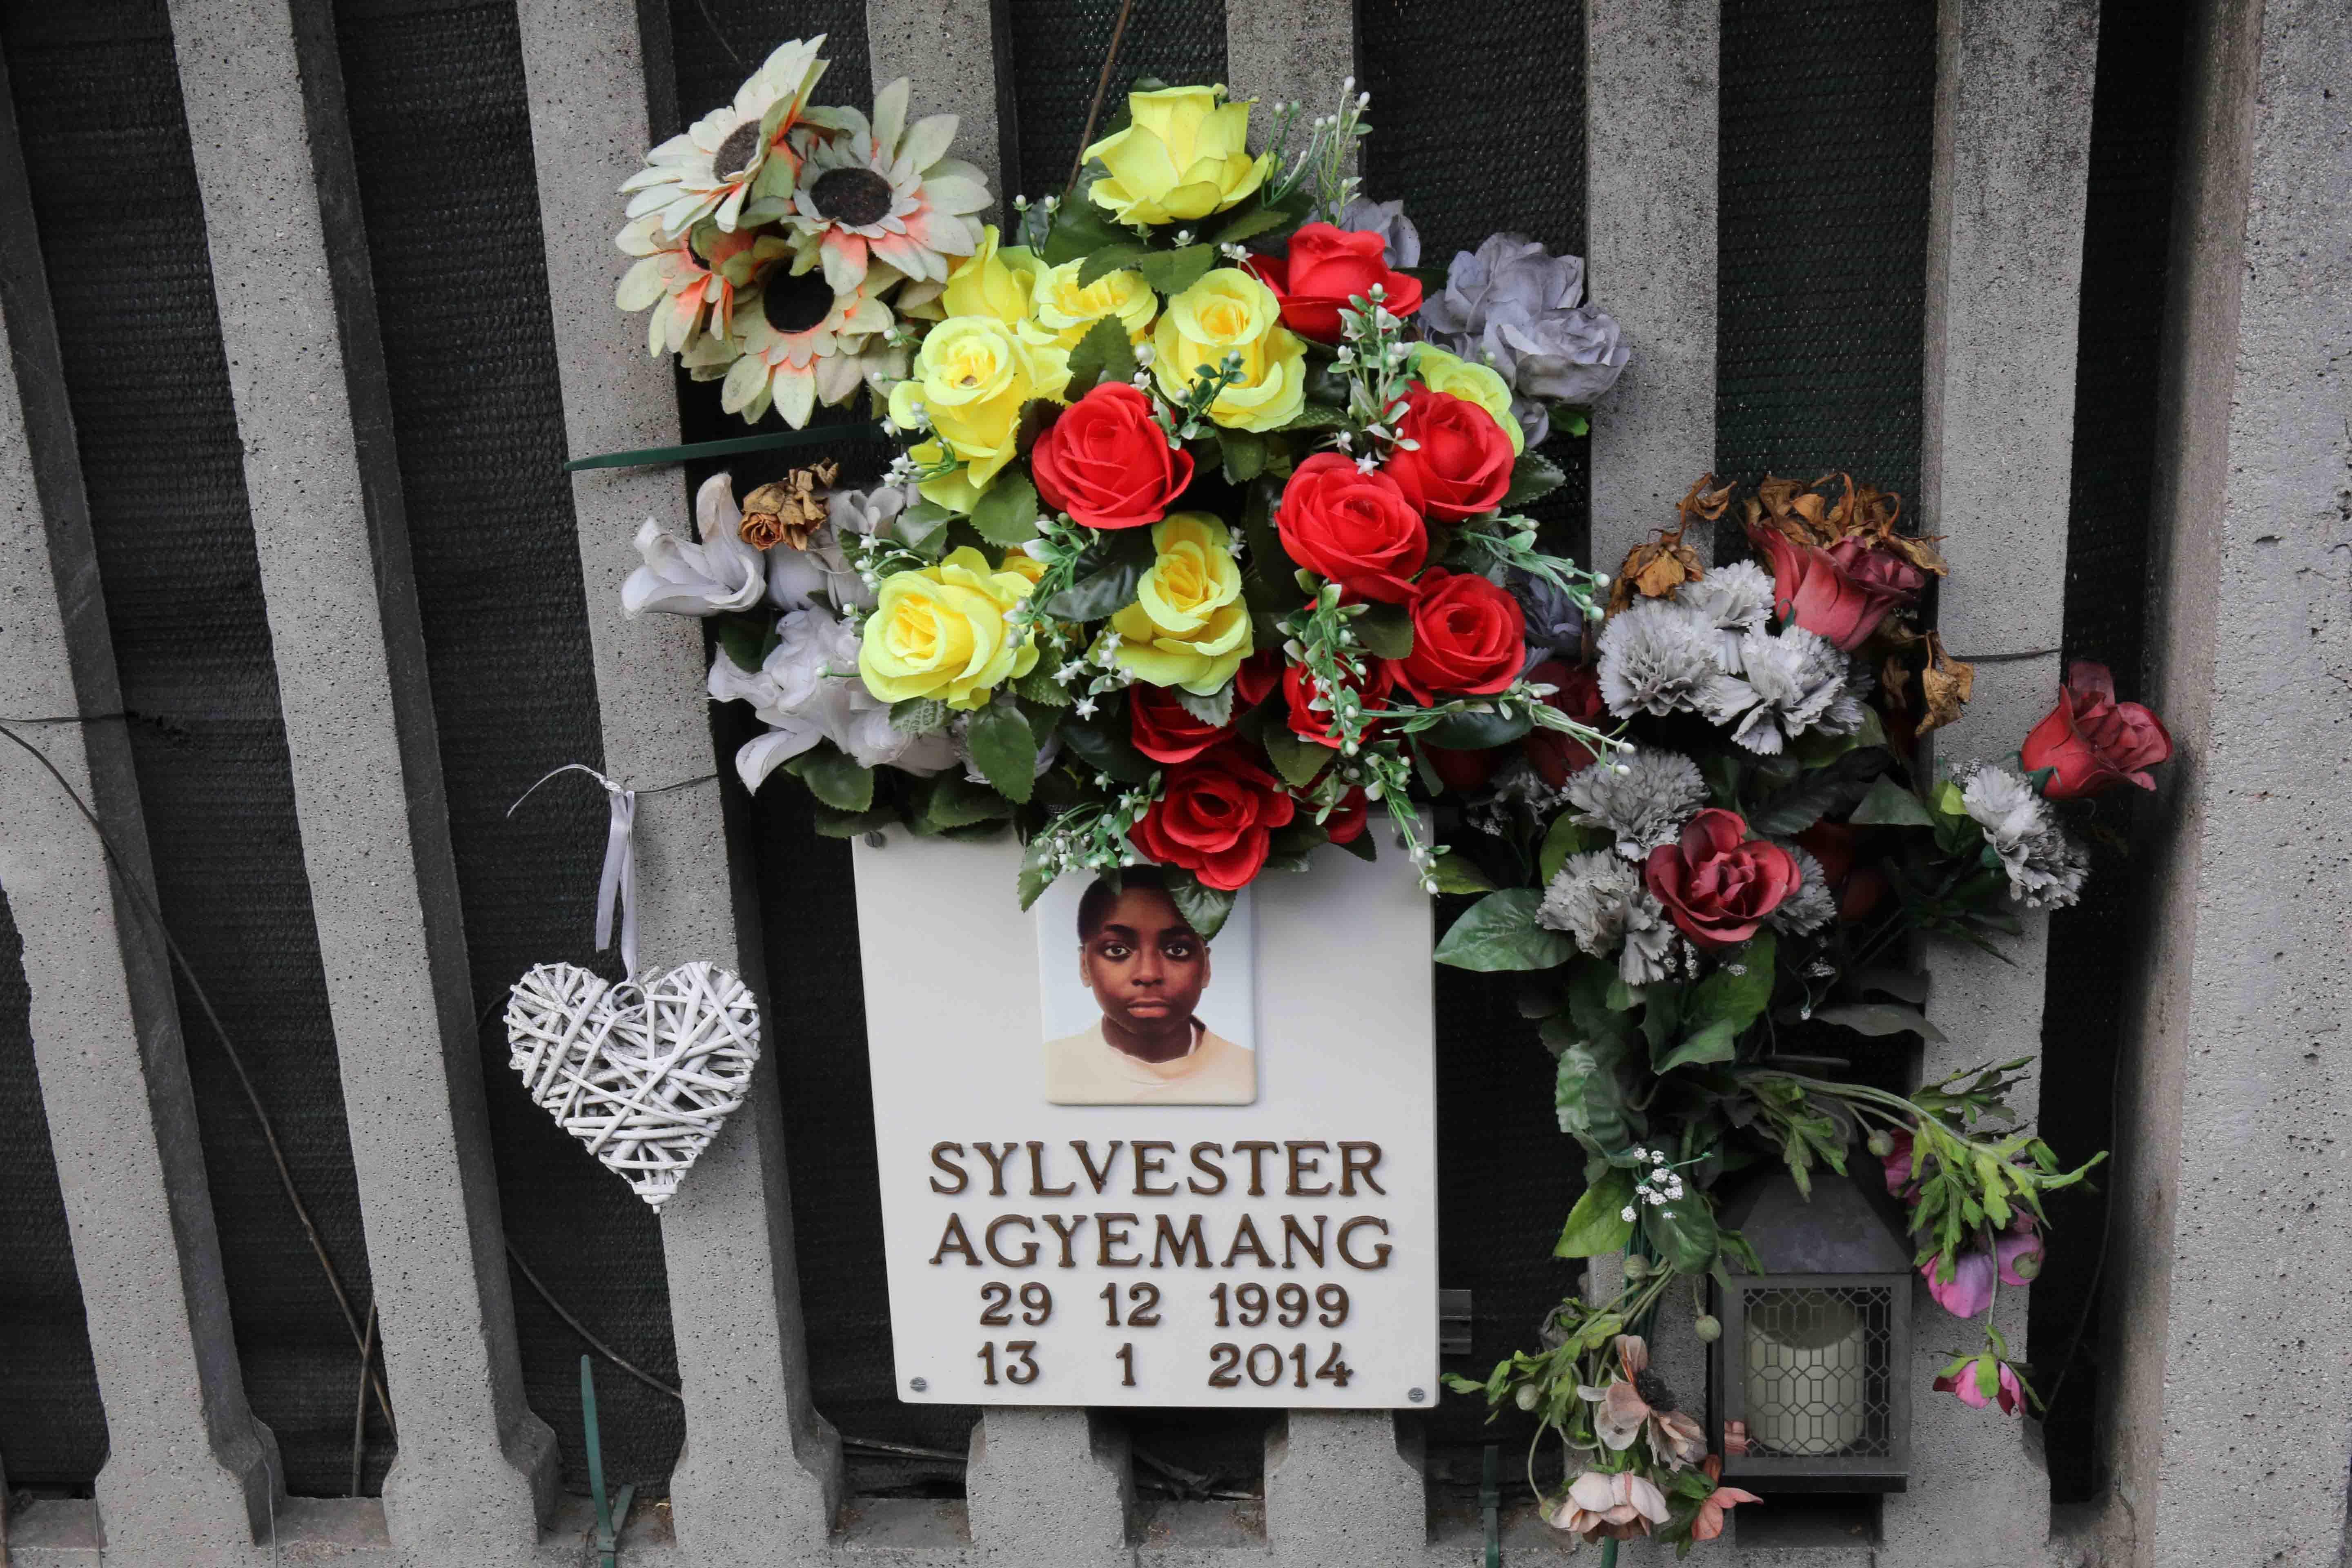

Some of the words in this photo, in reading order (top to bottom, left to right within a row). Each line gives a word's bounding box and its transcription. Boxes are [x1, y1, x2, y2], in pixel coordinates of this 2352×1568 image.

[930, 1140, 1386, 1196] SYLVESTER
[929, 1213, 1392, 1270] AGYEMANG
[980, 1282, 1052, 1326] 29
[1100, 1283, 1160, 1327] 12
[1210, 1283, 1349, 1328] 1999
[978, 1341, 1039, 1385] 13
[1116, 1343, 1136, 1386] 1
[1208, 1343, 1354, 1388] 2014
